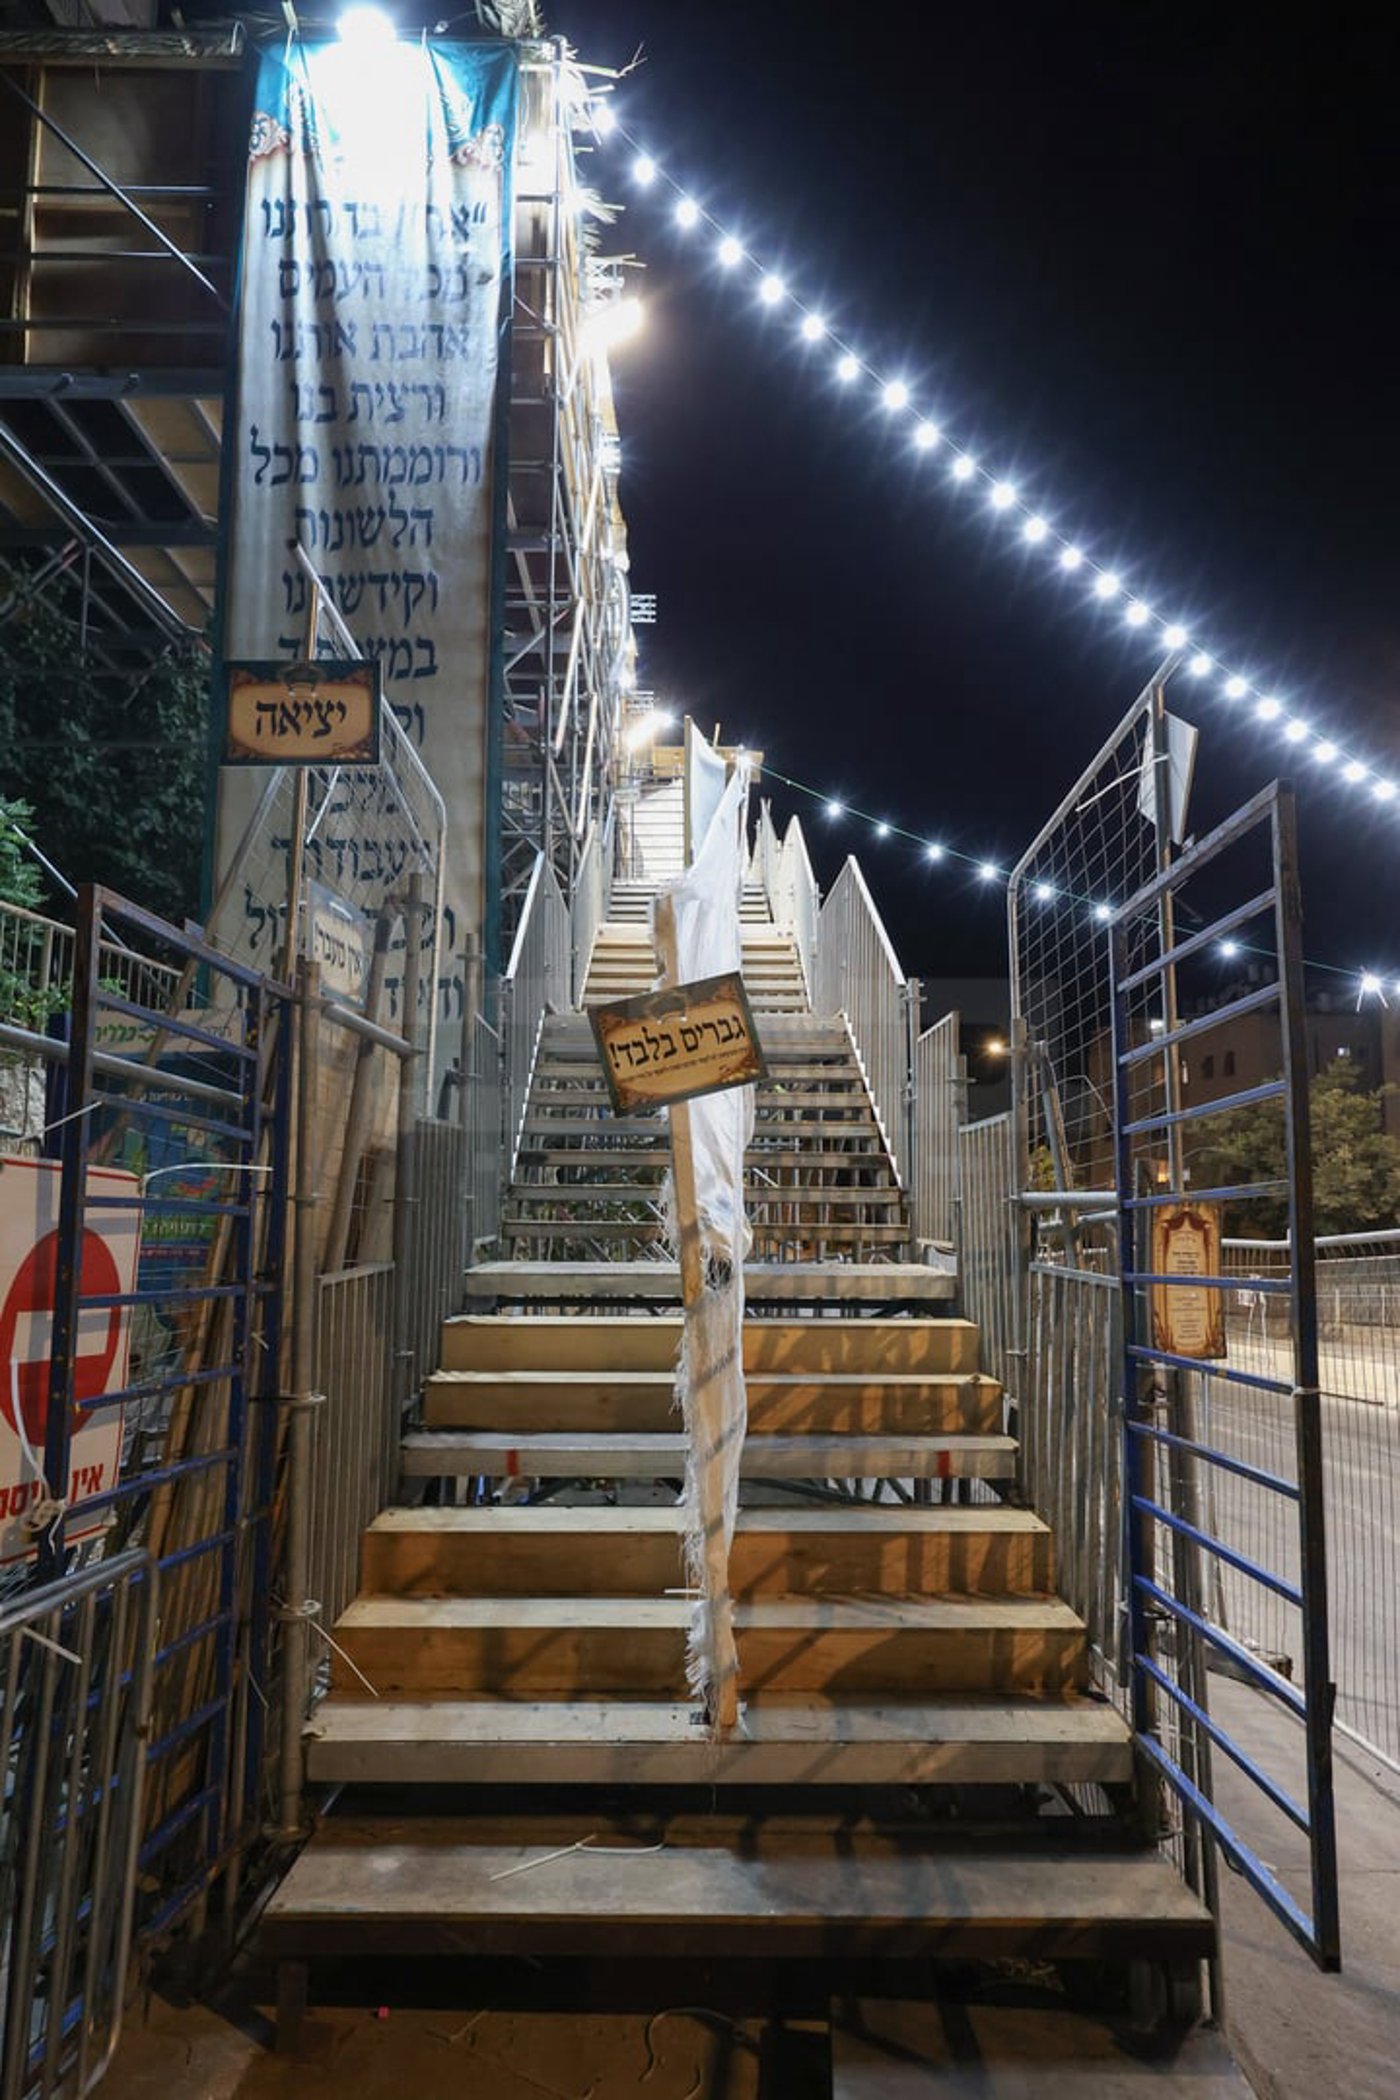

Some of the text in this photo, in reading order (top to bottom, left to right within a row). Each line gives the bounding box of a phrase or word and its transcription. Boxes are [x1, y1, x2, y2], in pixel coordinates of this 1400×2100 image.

[346, 379, 446, 424] ורצית
[249, 424, 482, 486] ורוממתנו מכל
[293, 489, 435, 551] הלשונות
[256, 700, 347, 738] יציאה
[609, 1026, 678, 1069] בלבד!
[679, 1014, 746, 1052] גברים
[69, 1462, 104, 1506] אין
